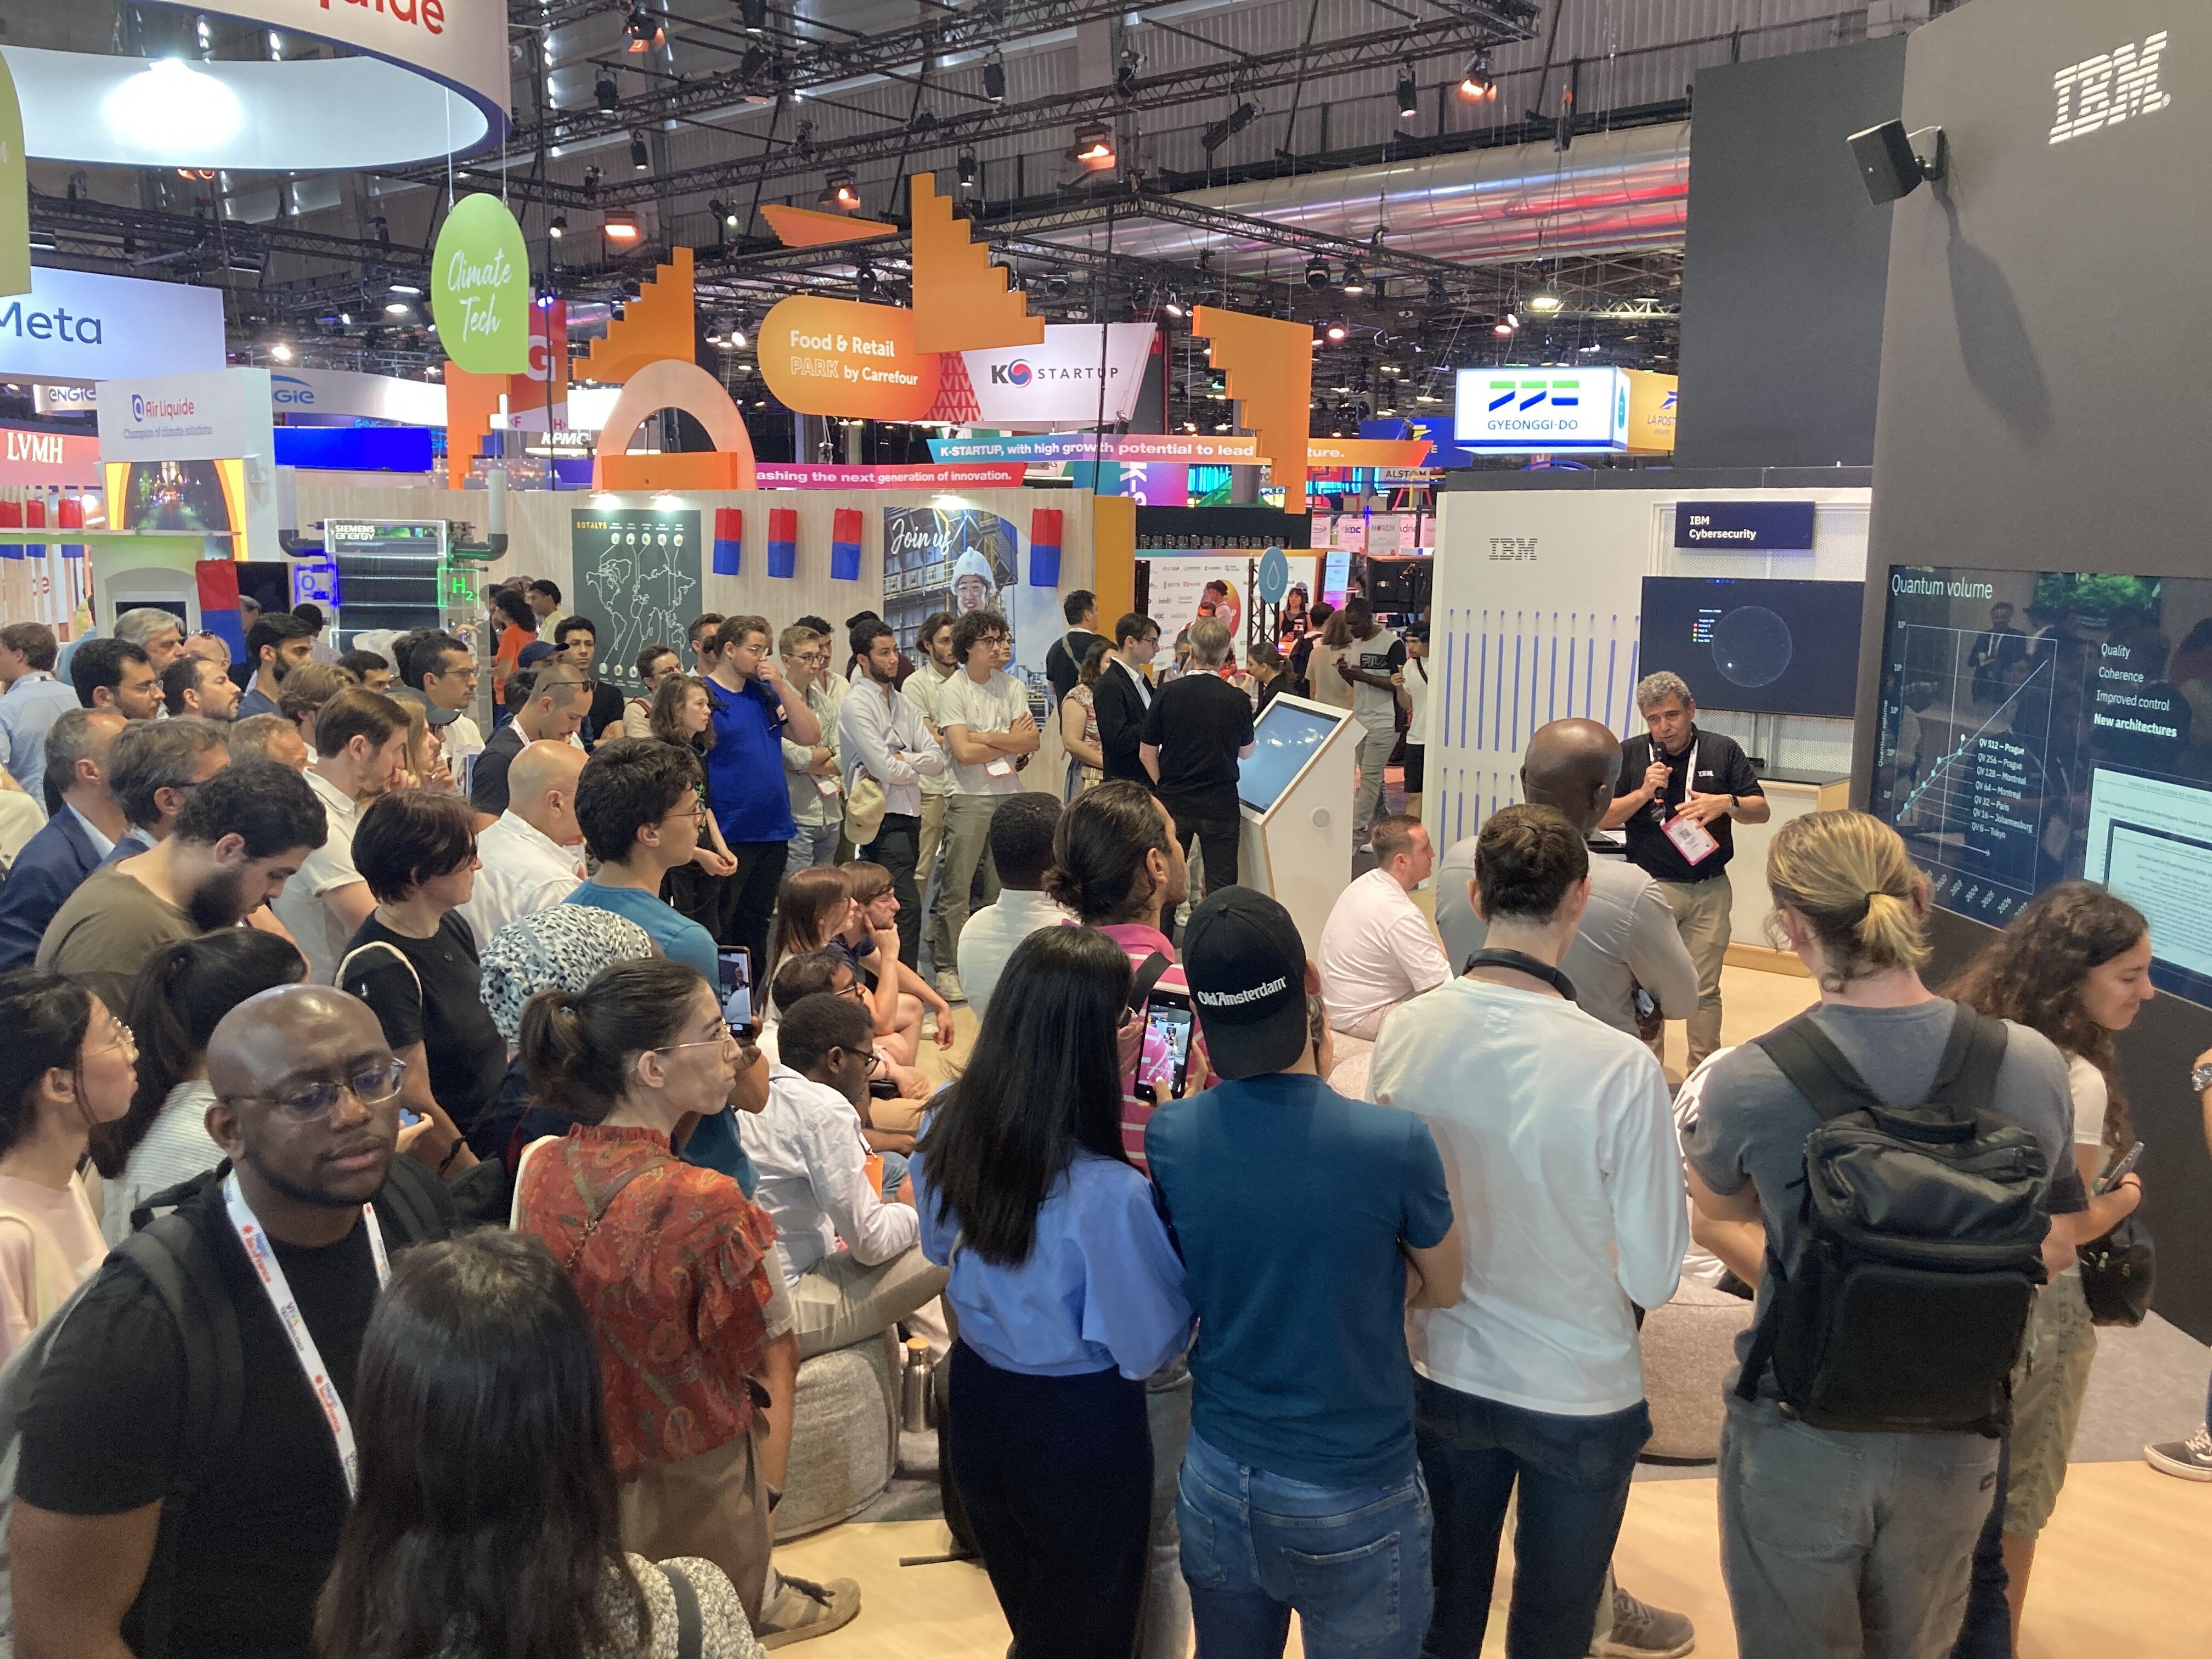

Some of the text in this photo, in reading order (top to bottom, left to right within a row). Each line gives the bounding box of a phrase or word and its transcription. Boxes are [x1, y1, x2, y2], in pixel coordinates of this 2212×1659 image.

[2049, 30, 2167, 144] IBM
[448, 247, 512, 291] Climate
[0, 301, 101, 344] Meta
[460, 293, 500, 342] Tech
[790, 330, 895, 357] Food & Retail
[525, 335, 556, 381] G
[791, 356, 918, 386] PARK by Carrefour
[1038, 368, 1119, 380] STARTUP
[146, 398, 194, 420] Air Liquide
[515, 416, 521, 427] F
[554, 419, 562, 430] H
[1487, 419, 1578, 430] GYEONGGI-DO
[1647, 415, 1677, 426] LA POST
[7, 432, 64, 464] LVMH
[940, 443, 1345, 458] K-STARTUP, with high growth potential to lead ture.
[757, 470, 1012, 484] ashing the next generation of innovation.
[335, 525, 375, 533] SIEMENS
[576, 521, 607, 530] BOTALYS
[1690, 516, 1709, 525] IBM
[891, 518, 953, 556] Join us
[1689, 528, 1756, 540] Cybersecurity
[1489, 538, 1538, 560] IBM
[1892, 574, 1993, 599] Quantum volume
[2101, 643, 2131, 659] Quality
[2099, 667, 2144, 682] Coherence
[2096, 690, 2170, 711] Improved control
[2094, 713, 2177, 737] New architectures
[1979, 738, 1987, 747] QV
[1988, 740, 1999, 749] 512
[2005, 743, 2024, 755] Prague
[1978, 753, 1985, 762] QV
[1986, 755, 1996, 764] 256
[2004, 758, 2022, 770] Prague
[1977, 766, 1984, 776] QV
[1985, 768, 1996, 778] 128
[2001, 771, 2027, 785] Montreal
[1976, 781, 1983, 790] QV
[1983, 783, 1991, 792] 64
[1997, 786, 2021, 799] Montreal
[1974, 795, 1982, 805] QV
[1982, 797, 1990, 806] 32
[1996, 800, 2009, 812] Paris
[1973, 808, 1981, 817] QV
[1982, 810, 1989, 819] 16
[1995, 814, 2033, 834] Johannesburg
[1971, 822, 1979, 832] QV
[1990, 827, 2006, 840] Tokyo
[1936, 874, 1948, 891] 2022
[1966, 885, 1978, 902] 2024
[1981, 890, 1995, 909] 2025
[1997, 896, 2012, 915] 2026
[1198, 978, 1286, 1006] Old Amsterdam
